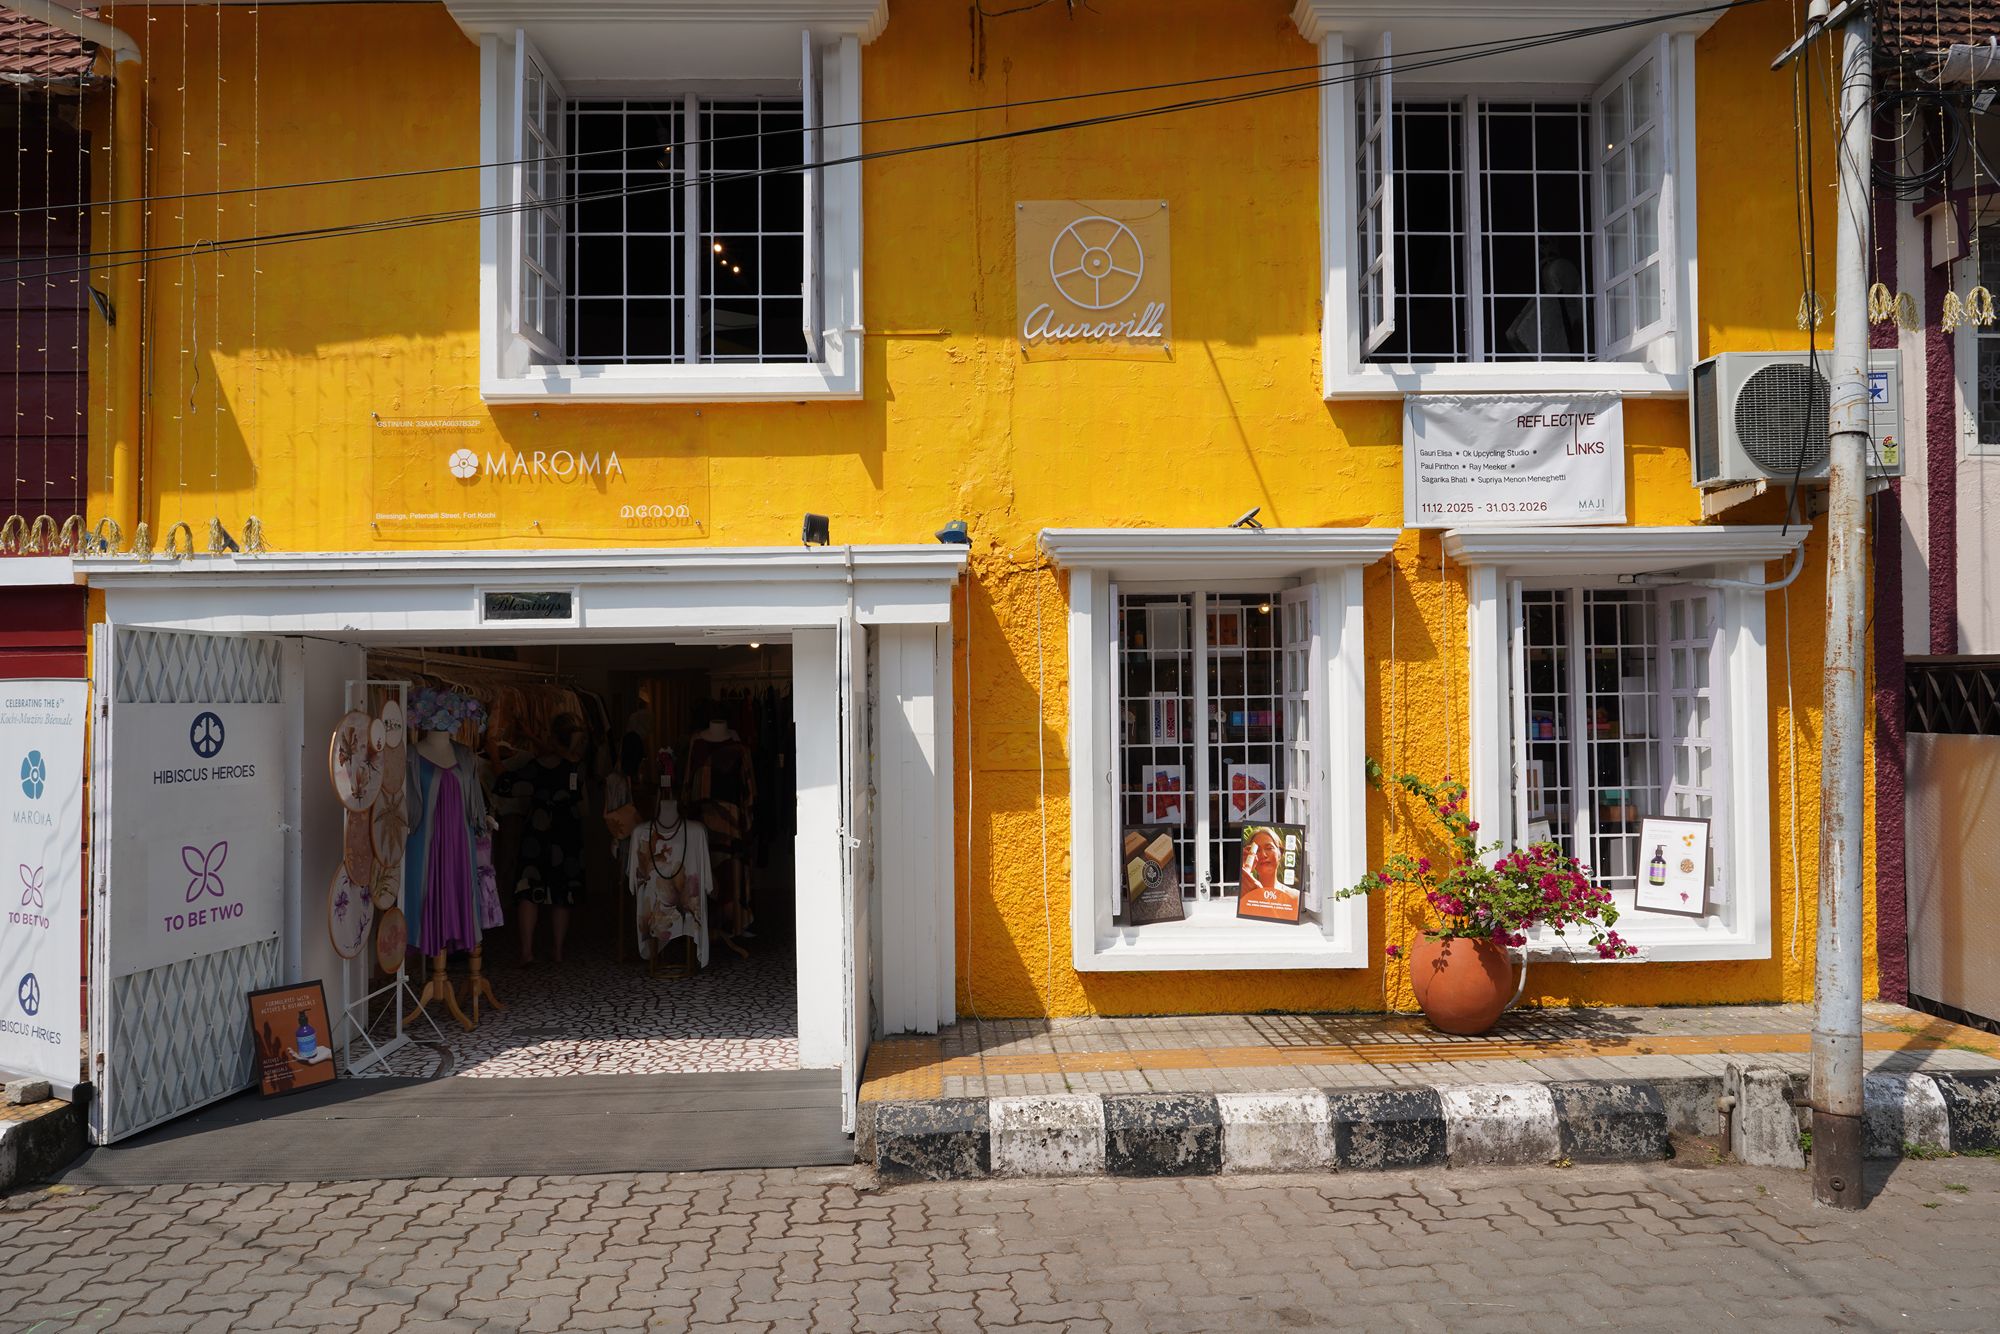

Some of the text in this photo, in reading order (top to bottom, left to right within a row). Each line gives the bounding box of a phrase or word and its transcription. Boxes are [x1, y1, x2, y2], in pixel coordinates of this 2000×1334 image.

[1024, 302, 1165, 339] Auroville
[1517, 413, 1595, 428] REFLECTIVE
[1420, 449, 1436, 457] Gauri
[1473, 450, 1505, 459] Upcycling
[1507, 449, 1530, 457] Studio
[1567, 441, 1605, 456] LINKS
[485, 450, 623, 475] MAROMA
[1469, 463, 1482, 472] Ray
[1421, 476, 1449, 484] Sagarika
[1478, 476, 1502, 485] Supriya
[1527, 474, 1566, 484] Meneghetti
[1421, 503, 1474, 513] 11.12.2025
[1486, 502, 1548, 512] 31.03.2026
[1578, 499, 1605, 509] MAJI
[376, 512, 408, 520] Blessings,
[440, 512, 462, 520] Street,
[492, 598, 560, 616] Blessings
[5, 698, 42, 708] CELEBRATING
[44, 698, 55, 708] THE
[153, 764, 255, 785] HIBISCUS HEROES
[1264, 890, 1277, 900] 0%
[8, 912, 20, 924] TO
[22, 913, 33, 925] BE
[164, 902, 244, 933] TO BE TWO
